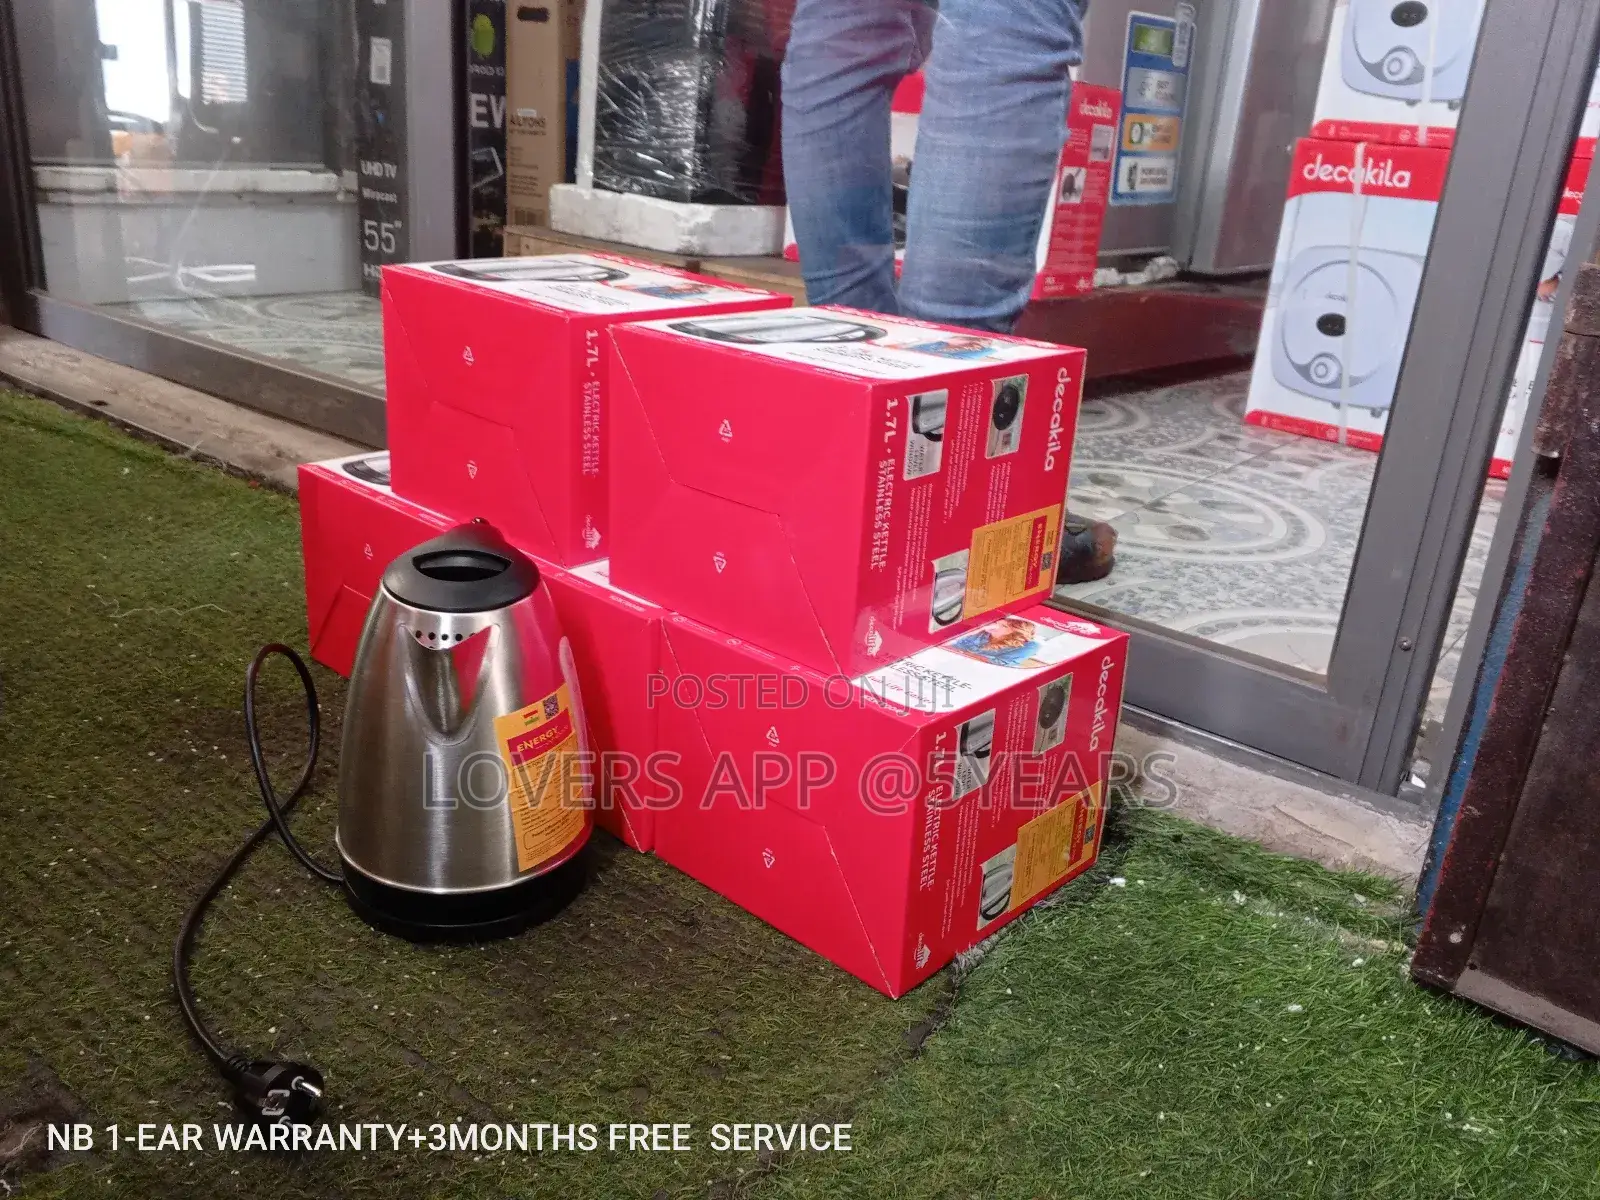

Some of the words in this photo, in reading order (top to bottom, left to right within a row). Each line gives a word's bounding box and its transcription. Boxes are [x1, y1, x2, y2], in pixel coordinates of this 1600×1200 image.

[1302, 153, 1412, 188] decakila
[585, 329, 599, 368] 1.7L
[884, 398, 899, 443] 1.7L
[1044, 366, 1071, 472] decakila
[874, 460, 887, 529] STAINLESS
[883, 459, 896, 519] ELECTRIC
[870, 531, 881, 570] STEEL
[1089, 655, 1112, 752] decakila
[517, 727, 558, 752] ENERGY
[923, 789, 936, 853] STAINLESS
[931, 785, 944, 842] ELECTRIC
[920, 855, 930, 892] STEEL
